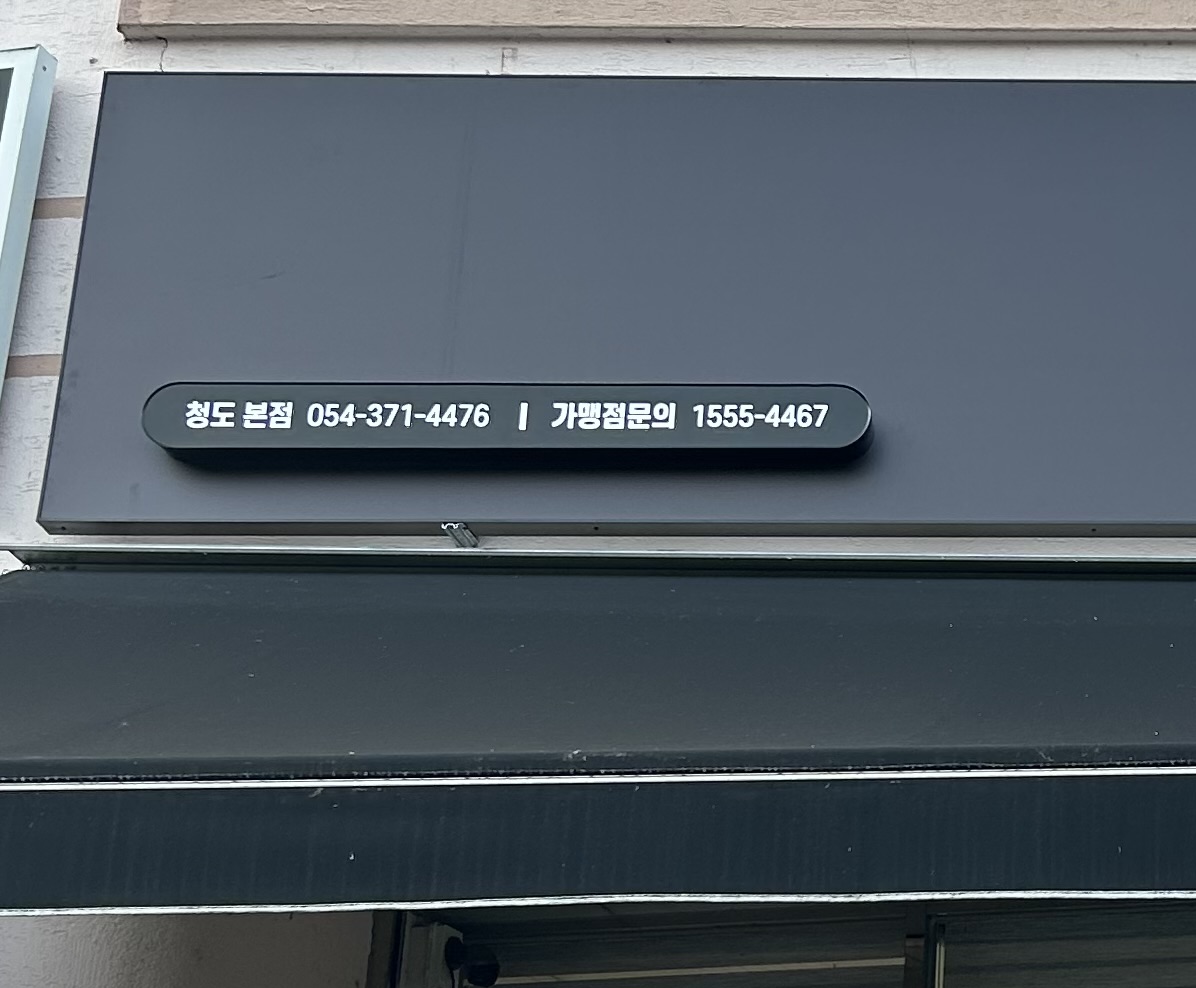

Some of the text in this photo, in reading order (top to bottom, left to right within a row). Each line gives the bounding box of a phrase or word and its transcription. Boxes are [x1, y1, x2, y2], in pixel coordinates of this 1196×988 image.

[184, 400, 830, 430] 청도 본점 054-371-4476 가맹점문의 1555-4467
